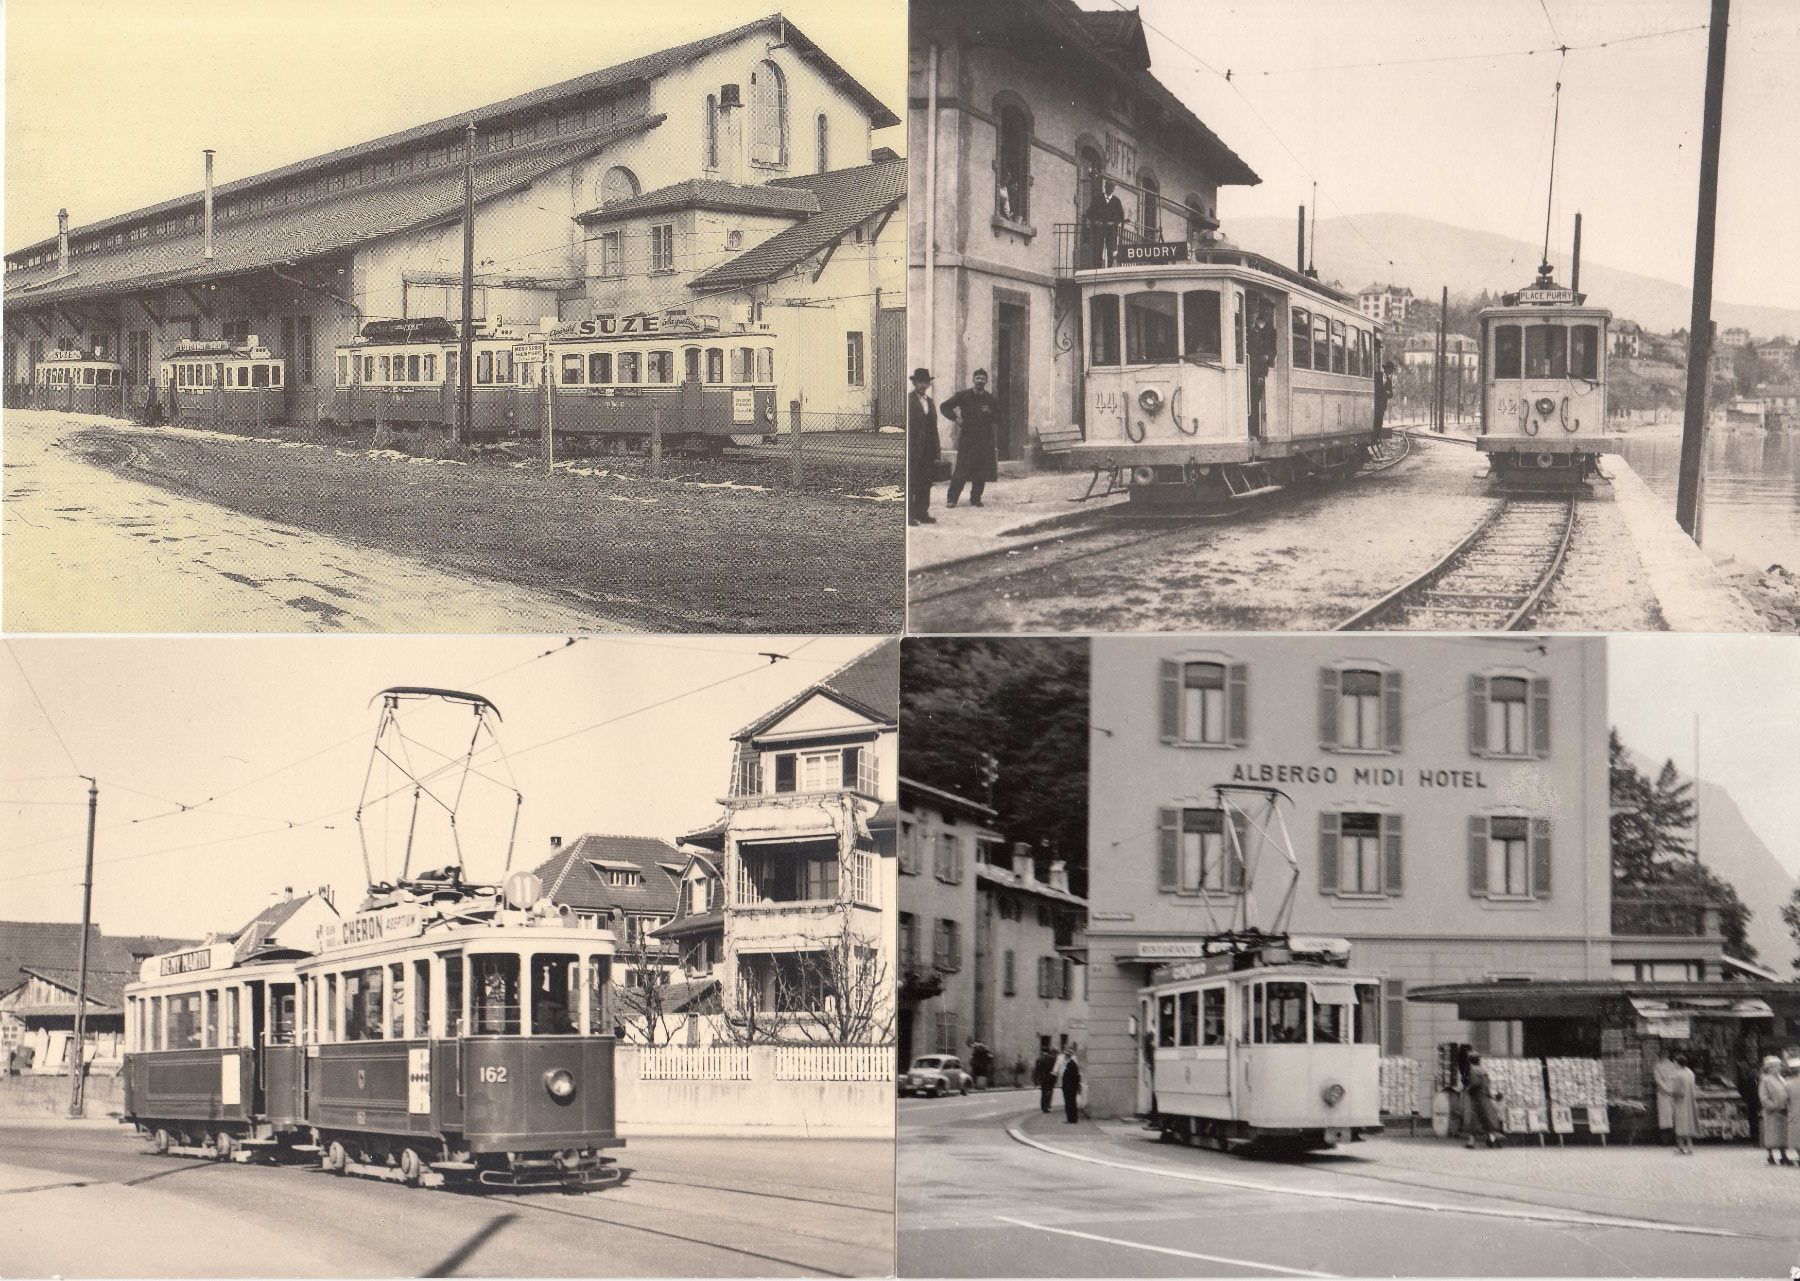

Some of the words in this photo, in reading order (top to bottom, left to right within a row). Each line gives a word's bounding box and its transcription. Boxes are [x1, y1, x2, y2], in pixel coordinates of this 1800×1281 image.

[1127, 246, 1177, 258] BOUDRY
[1521, 292, 1544, 300] PLACE
[1546, 292, 1572, 300] PURRY
[580, 317, 659, 334] SUZE
[1095, 392, 1118, 415] 44
[1497, 399, 1517, 415] 42
[1233, 764, 1338, 784] ALBERGO
[1353, 767, 1404, 787] MIDI
[1418, 769, 1487, 789] HOTEL
[342, 916, 383, 944] CHERON
[479, 1066, 508, 1083] 162
